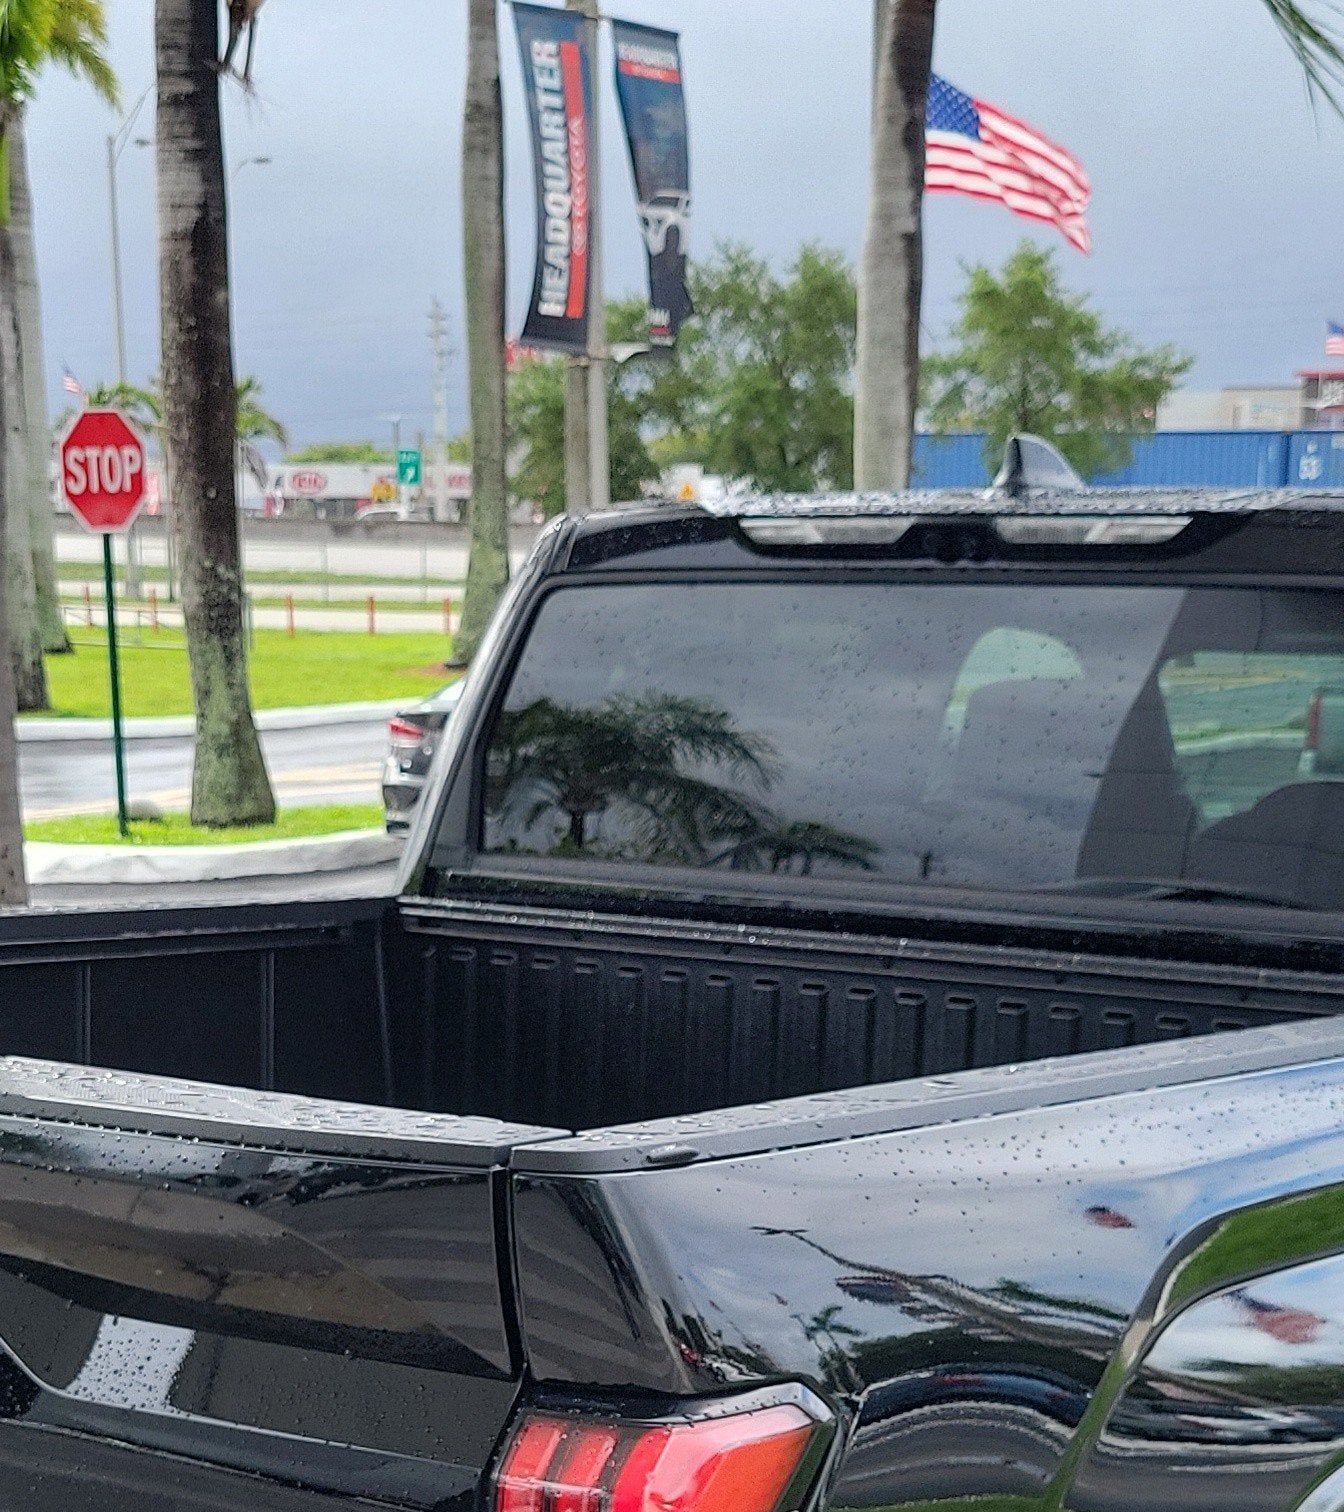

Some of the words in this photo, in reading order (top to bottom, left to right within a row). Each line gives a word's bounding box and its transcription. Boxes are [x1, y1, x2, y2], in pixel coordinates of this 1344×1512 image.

[530, 40, 573, 318] HEADQUARTER
[567, 116, 587, 219] TOYOTA
[64, 444, 142, 495] STOP
